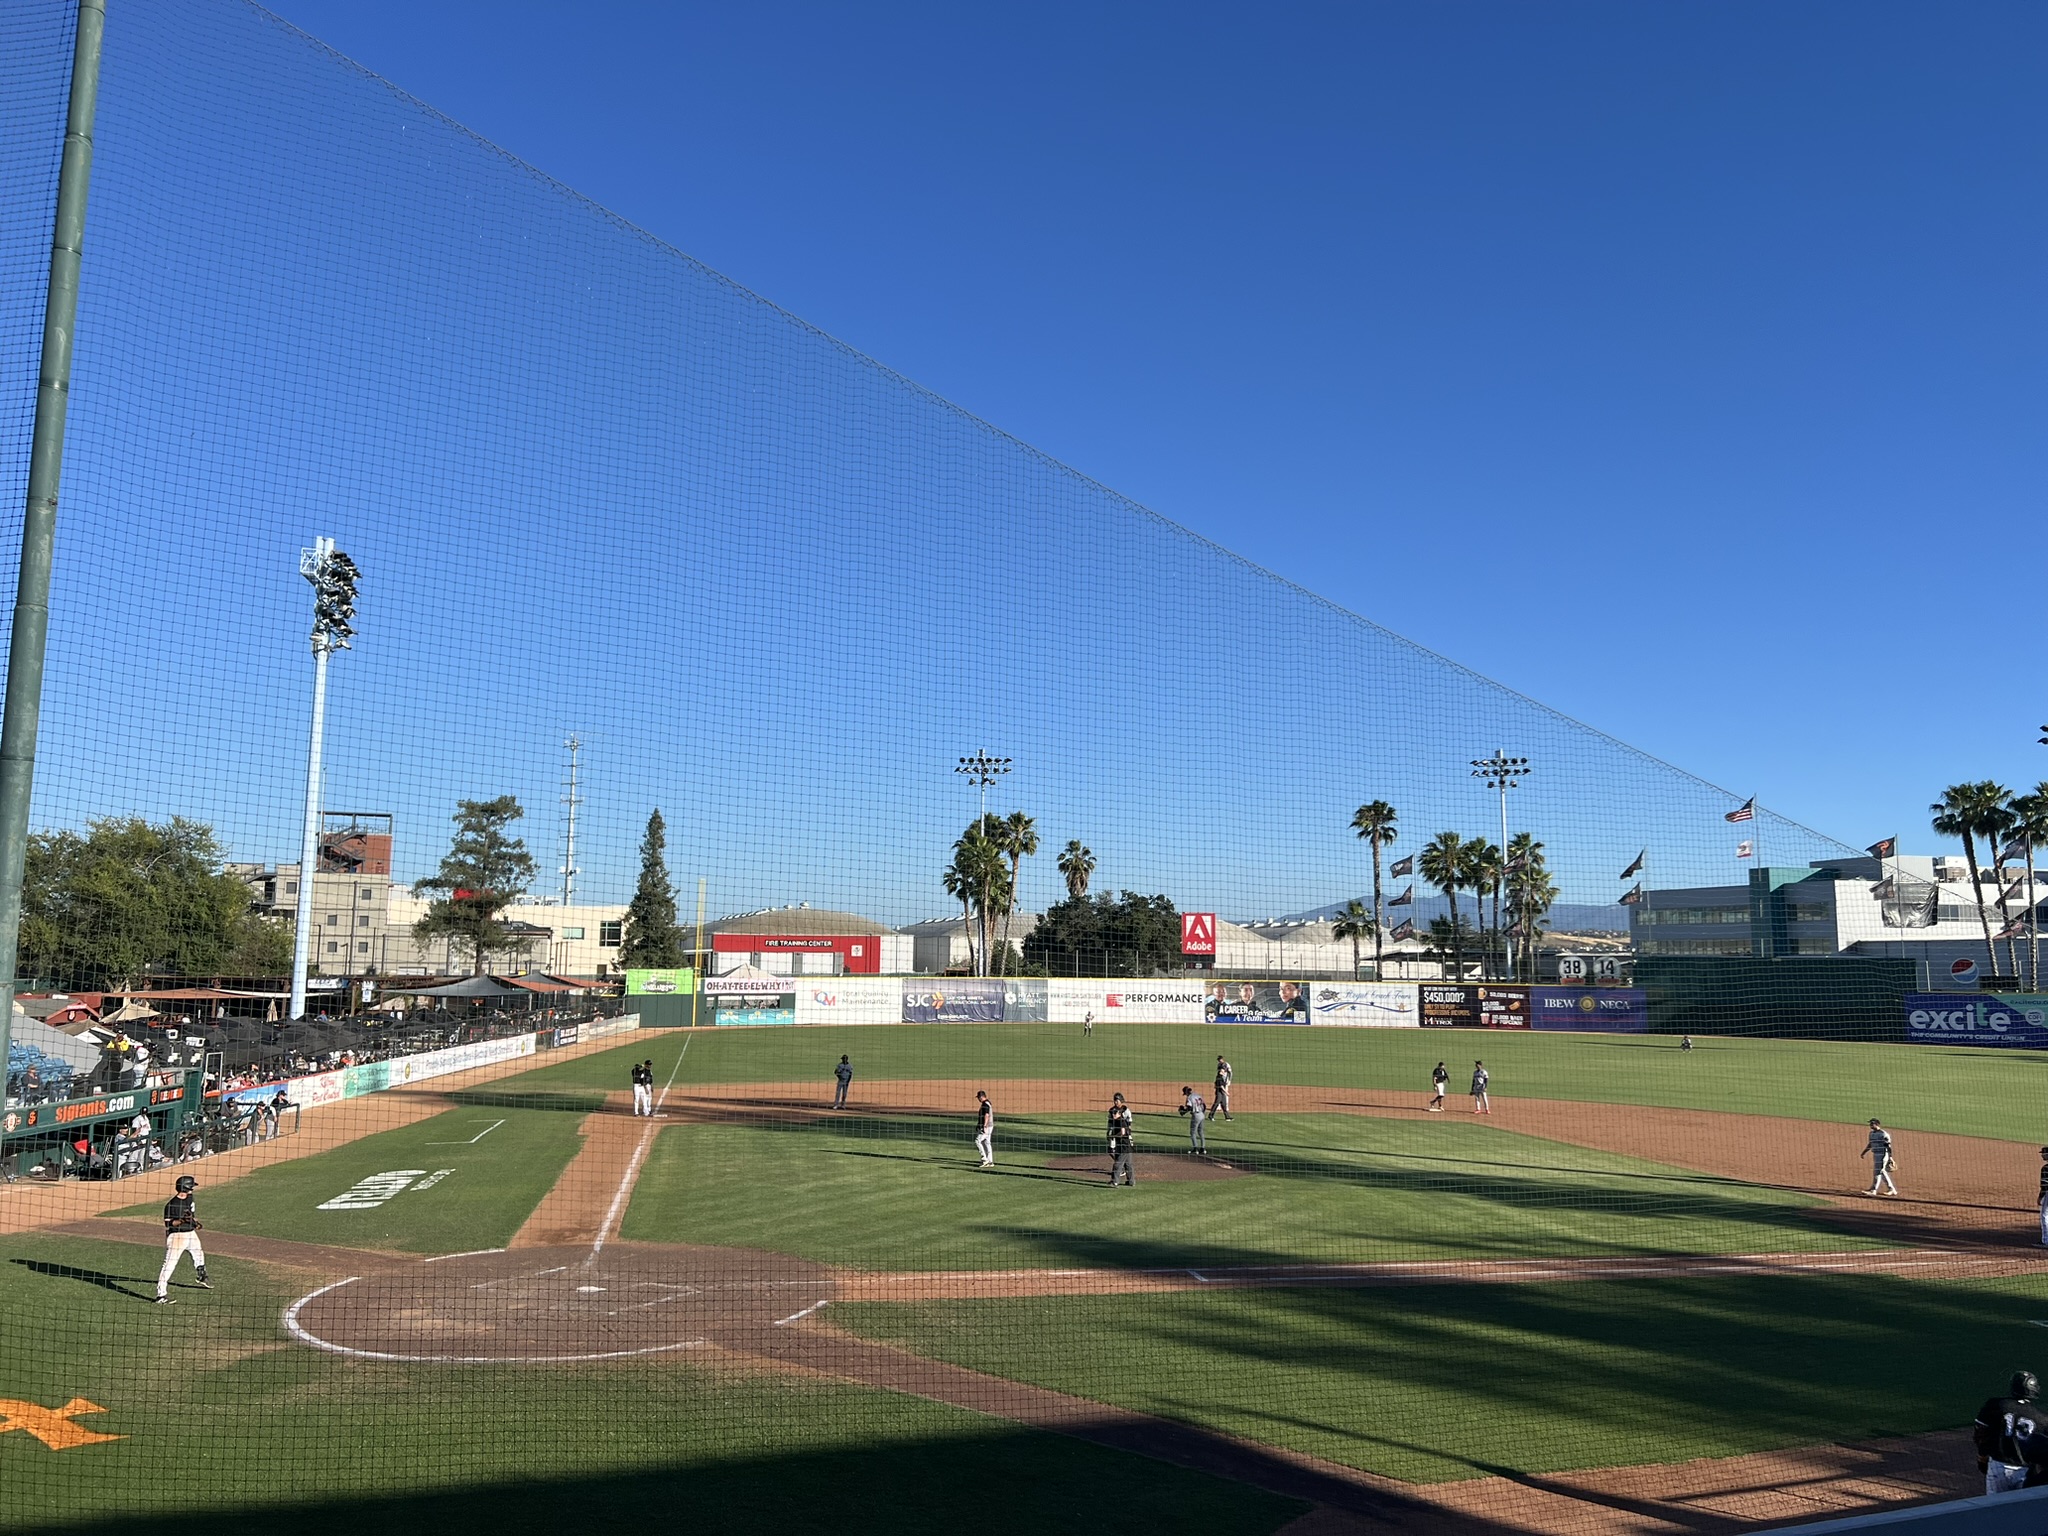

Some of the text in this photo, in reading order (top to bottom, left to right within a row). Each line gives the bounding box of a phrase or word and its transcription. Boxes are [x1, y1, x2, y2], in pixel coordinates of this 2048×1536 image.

[1186, 941, 1212, 951] Adobe
[1563, 960, 1581, 974] 38
[1600, 960, 1615, 974] 14
[811, 989, 836, 1006] TQM
[907, 994, 930, 1007] SJC
[1125, 993, 1203, 1003] PERFORMANCE
[1424, 991, 1465, 1003] $450,000?
[1544, 998, 1630, 1009] IBEW NECA
[1225, 1006, 1248, 1014] CAREER
[1241, 1014, 1262, 1022] Team
[1909, 1002, 2012, 1032] excite
[1925, 1032, 1974, 1040] COMMUNITY'S
[55, 1094, 135, 1123] sjgiants.com
